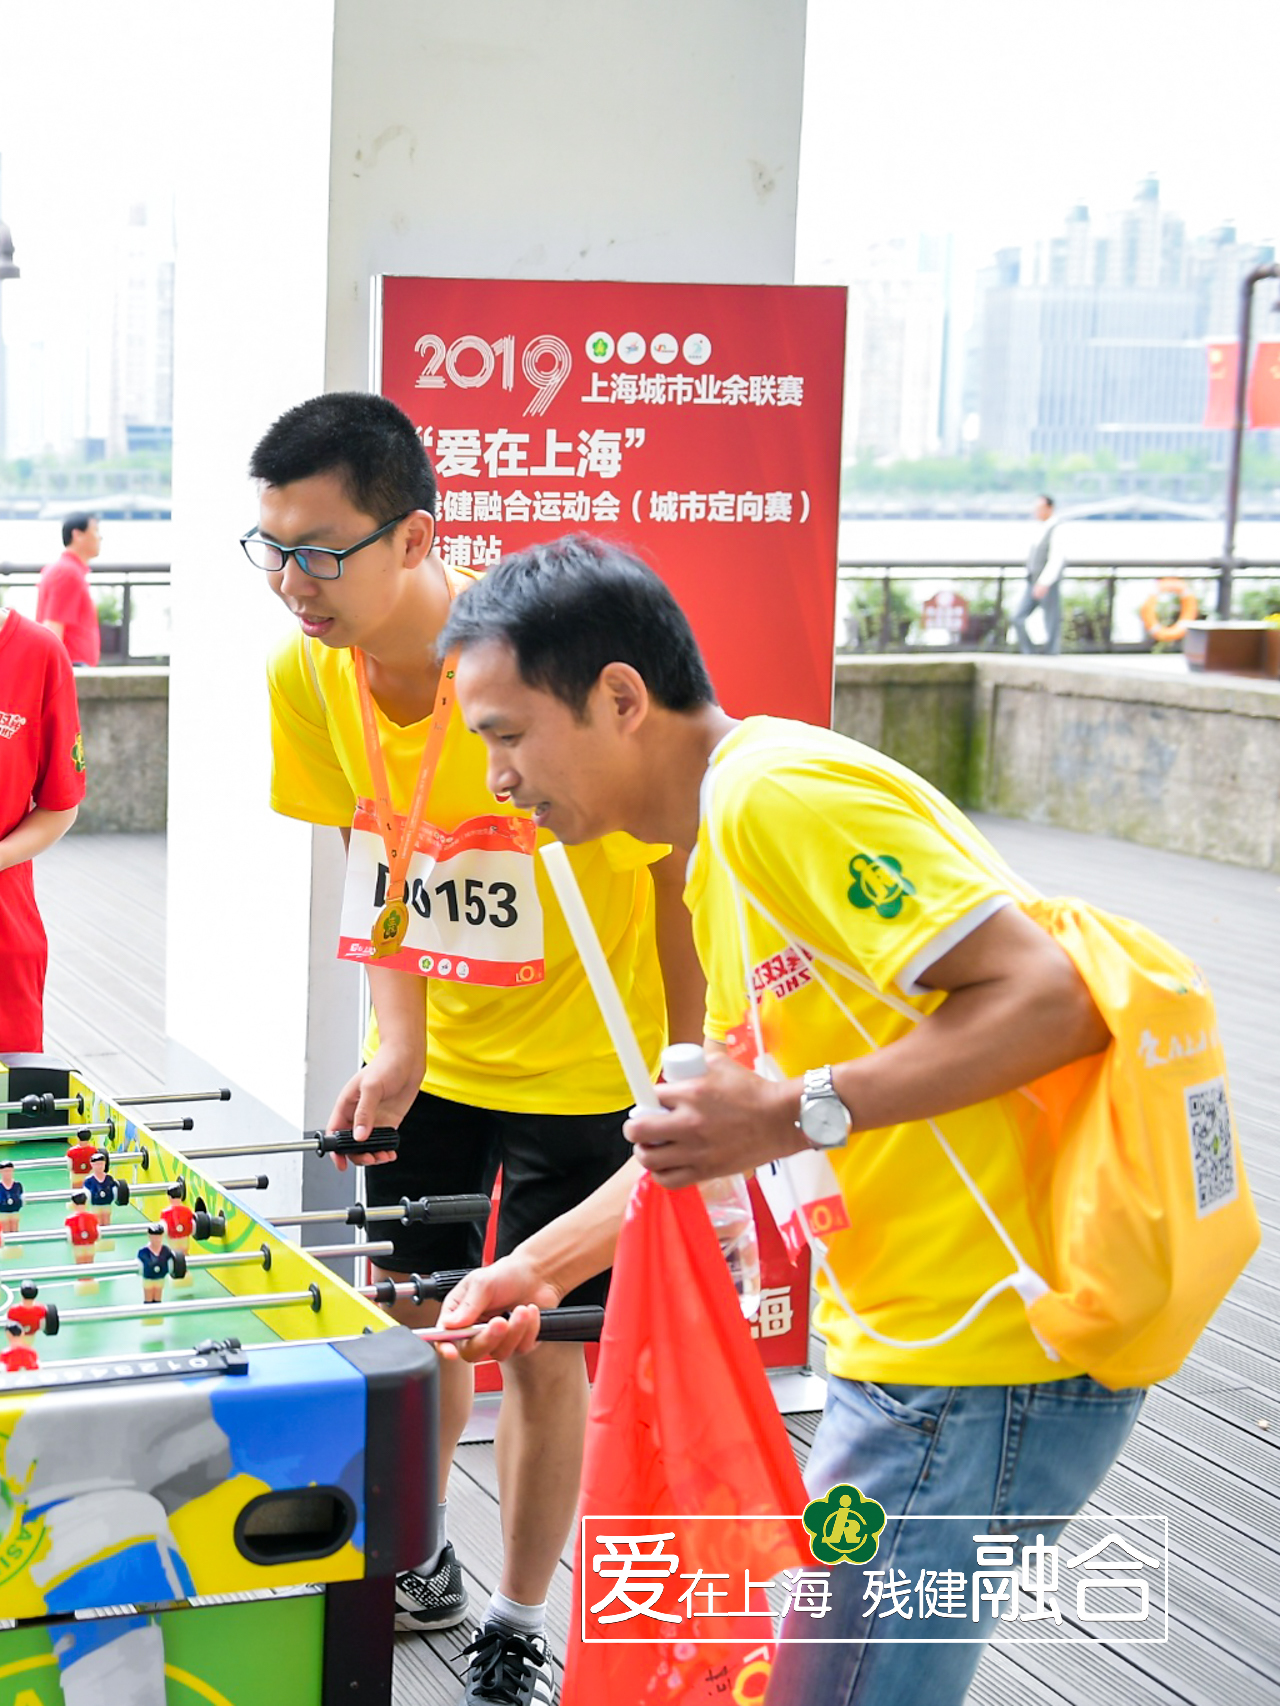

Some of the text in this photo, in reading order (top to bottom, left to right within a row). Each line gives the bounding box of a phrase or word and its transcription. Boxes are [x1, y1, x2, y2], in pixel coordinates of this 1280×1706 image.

[414, 334, 572, 417] 2019
[581, 372, 804, 406] 上海城市业余联赛
[435, 490, 810, 523] 健融合运动会（城市定向赛）
[434, 535, 502, 566] 浦站
